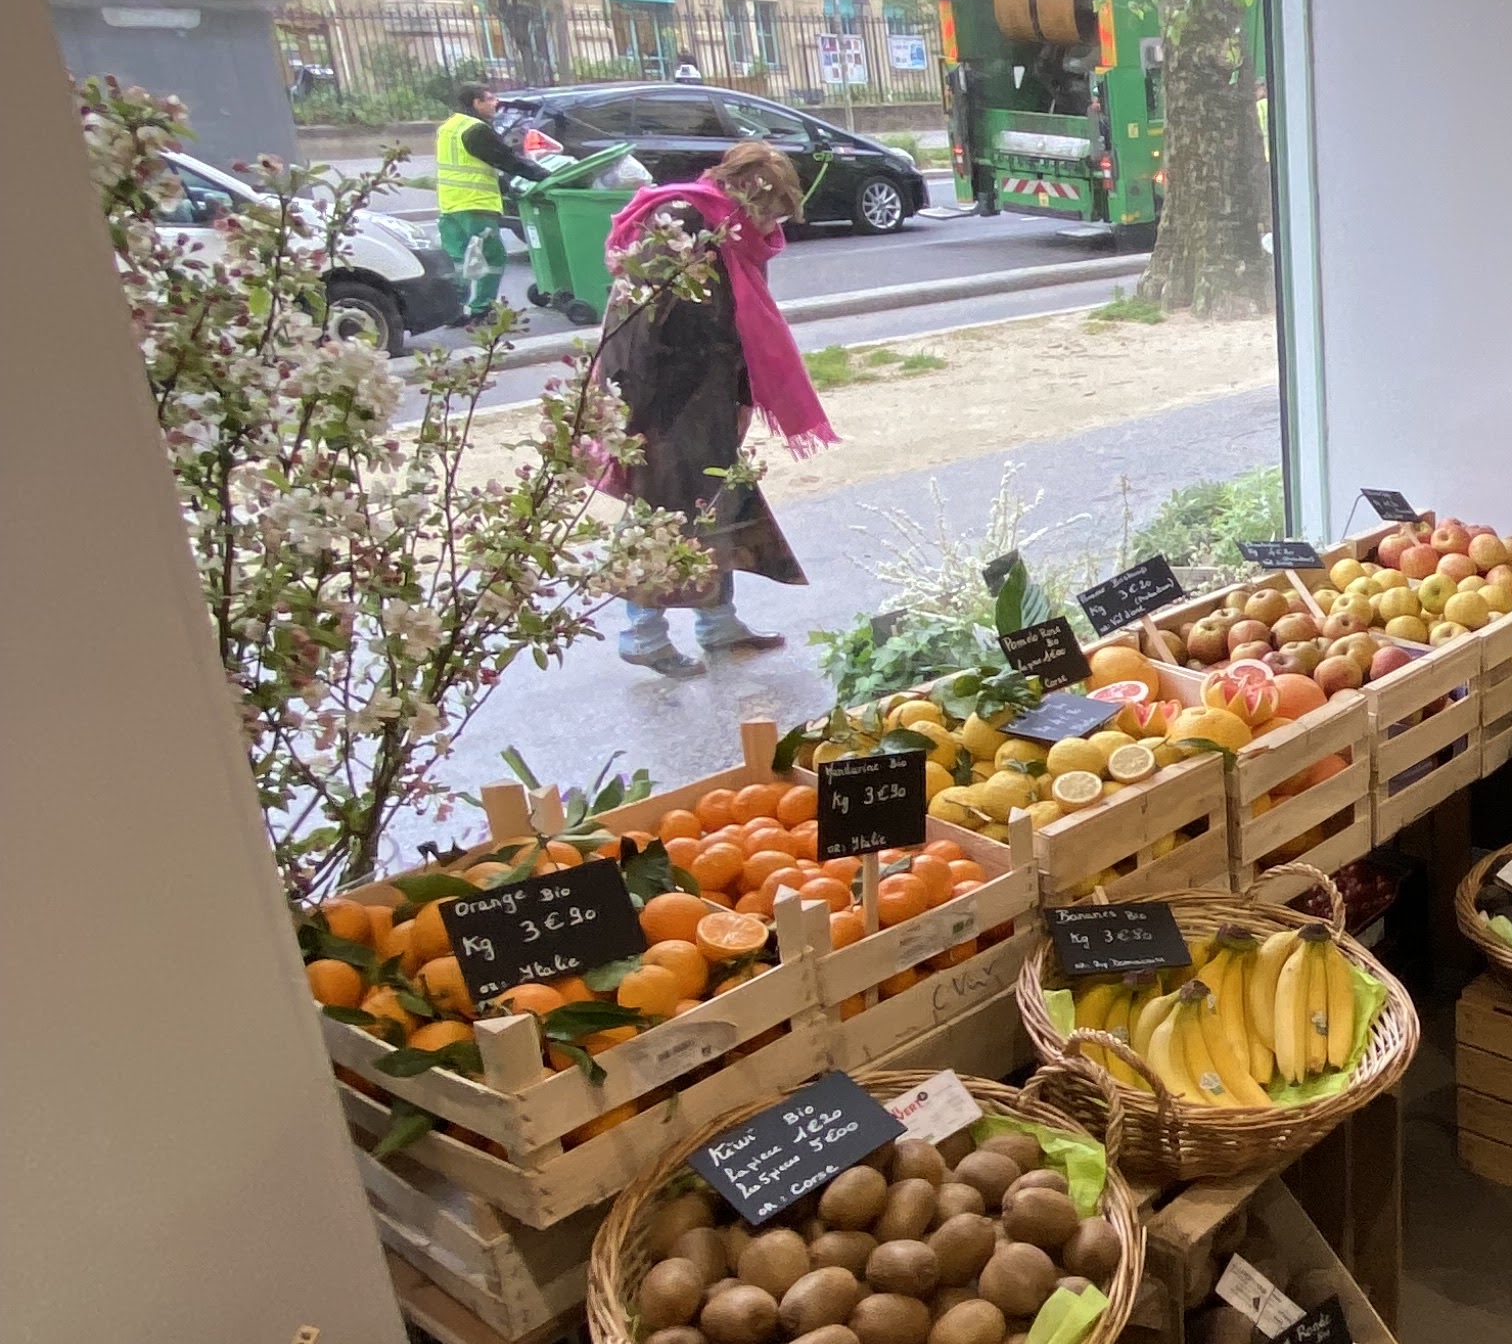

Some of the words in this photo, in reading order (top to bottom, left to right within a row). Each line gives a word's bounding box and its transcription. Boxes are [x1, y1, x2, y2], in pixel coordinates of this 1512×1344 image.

[832, 791, 849, 814] Kg
[455, 889, 527, 916] Orange
[538, 886, 571, 902] Bio
[1124, 910, 1147, 921] Bio
[462, 935, 494, 961] Kg
[1069, 932, 1090, 950] Kg
[783, 1105, 815, 1126] Bio
[808, 1121, 859, 1153] 5€00
[790, 1163, 840, 1196] Corse
